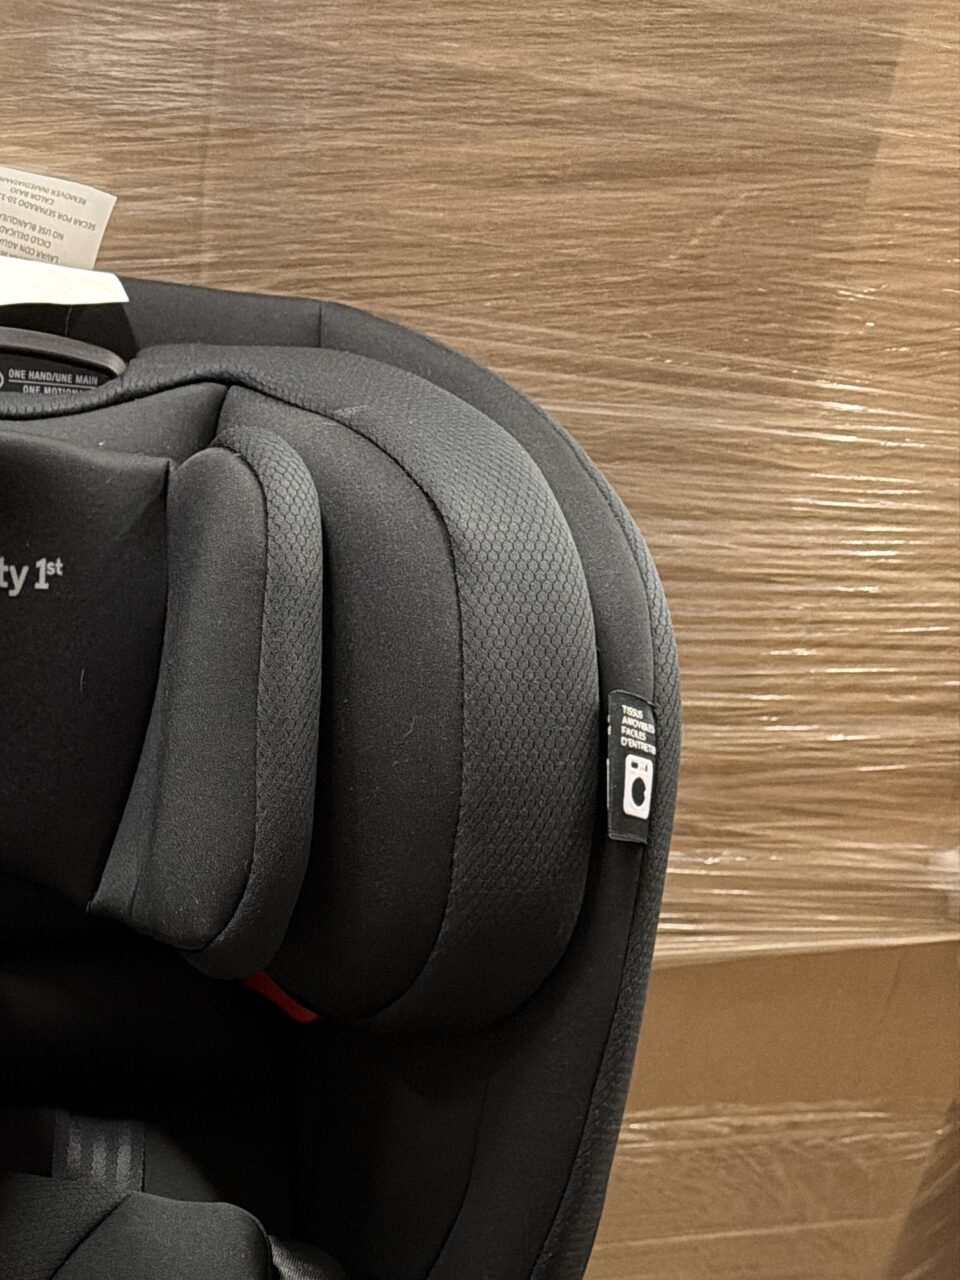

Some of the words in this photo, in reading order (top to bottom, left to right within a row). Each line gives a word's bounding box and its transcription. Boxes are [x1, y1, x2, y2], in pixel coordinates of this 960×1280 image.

[18, 199, 57, 218] SEPARADO
[37, 225, 52, 237] USE
[51, 230, 65, 241] NO
[30, 235, 52, 249] CICLO
[8, 368, 27, 380] ONE
[28, 370, 73, 384] HAND/UNE
[75, 374, 99, 386] MAIN
[34, 557, 64, 590] 1st
[621, 704, 644, 720] TISSUS
